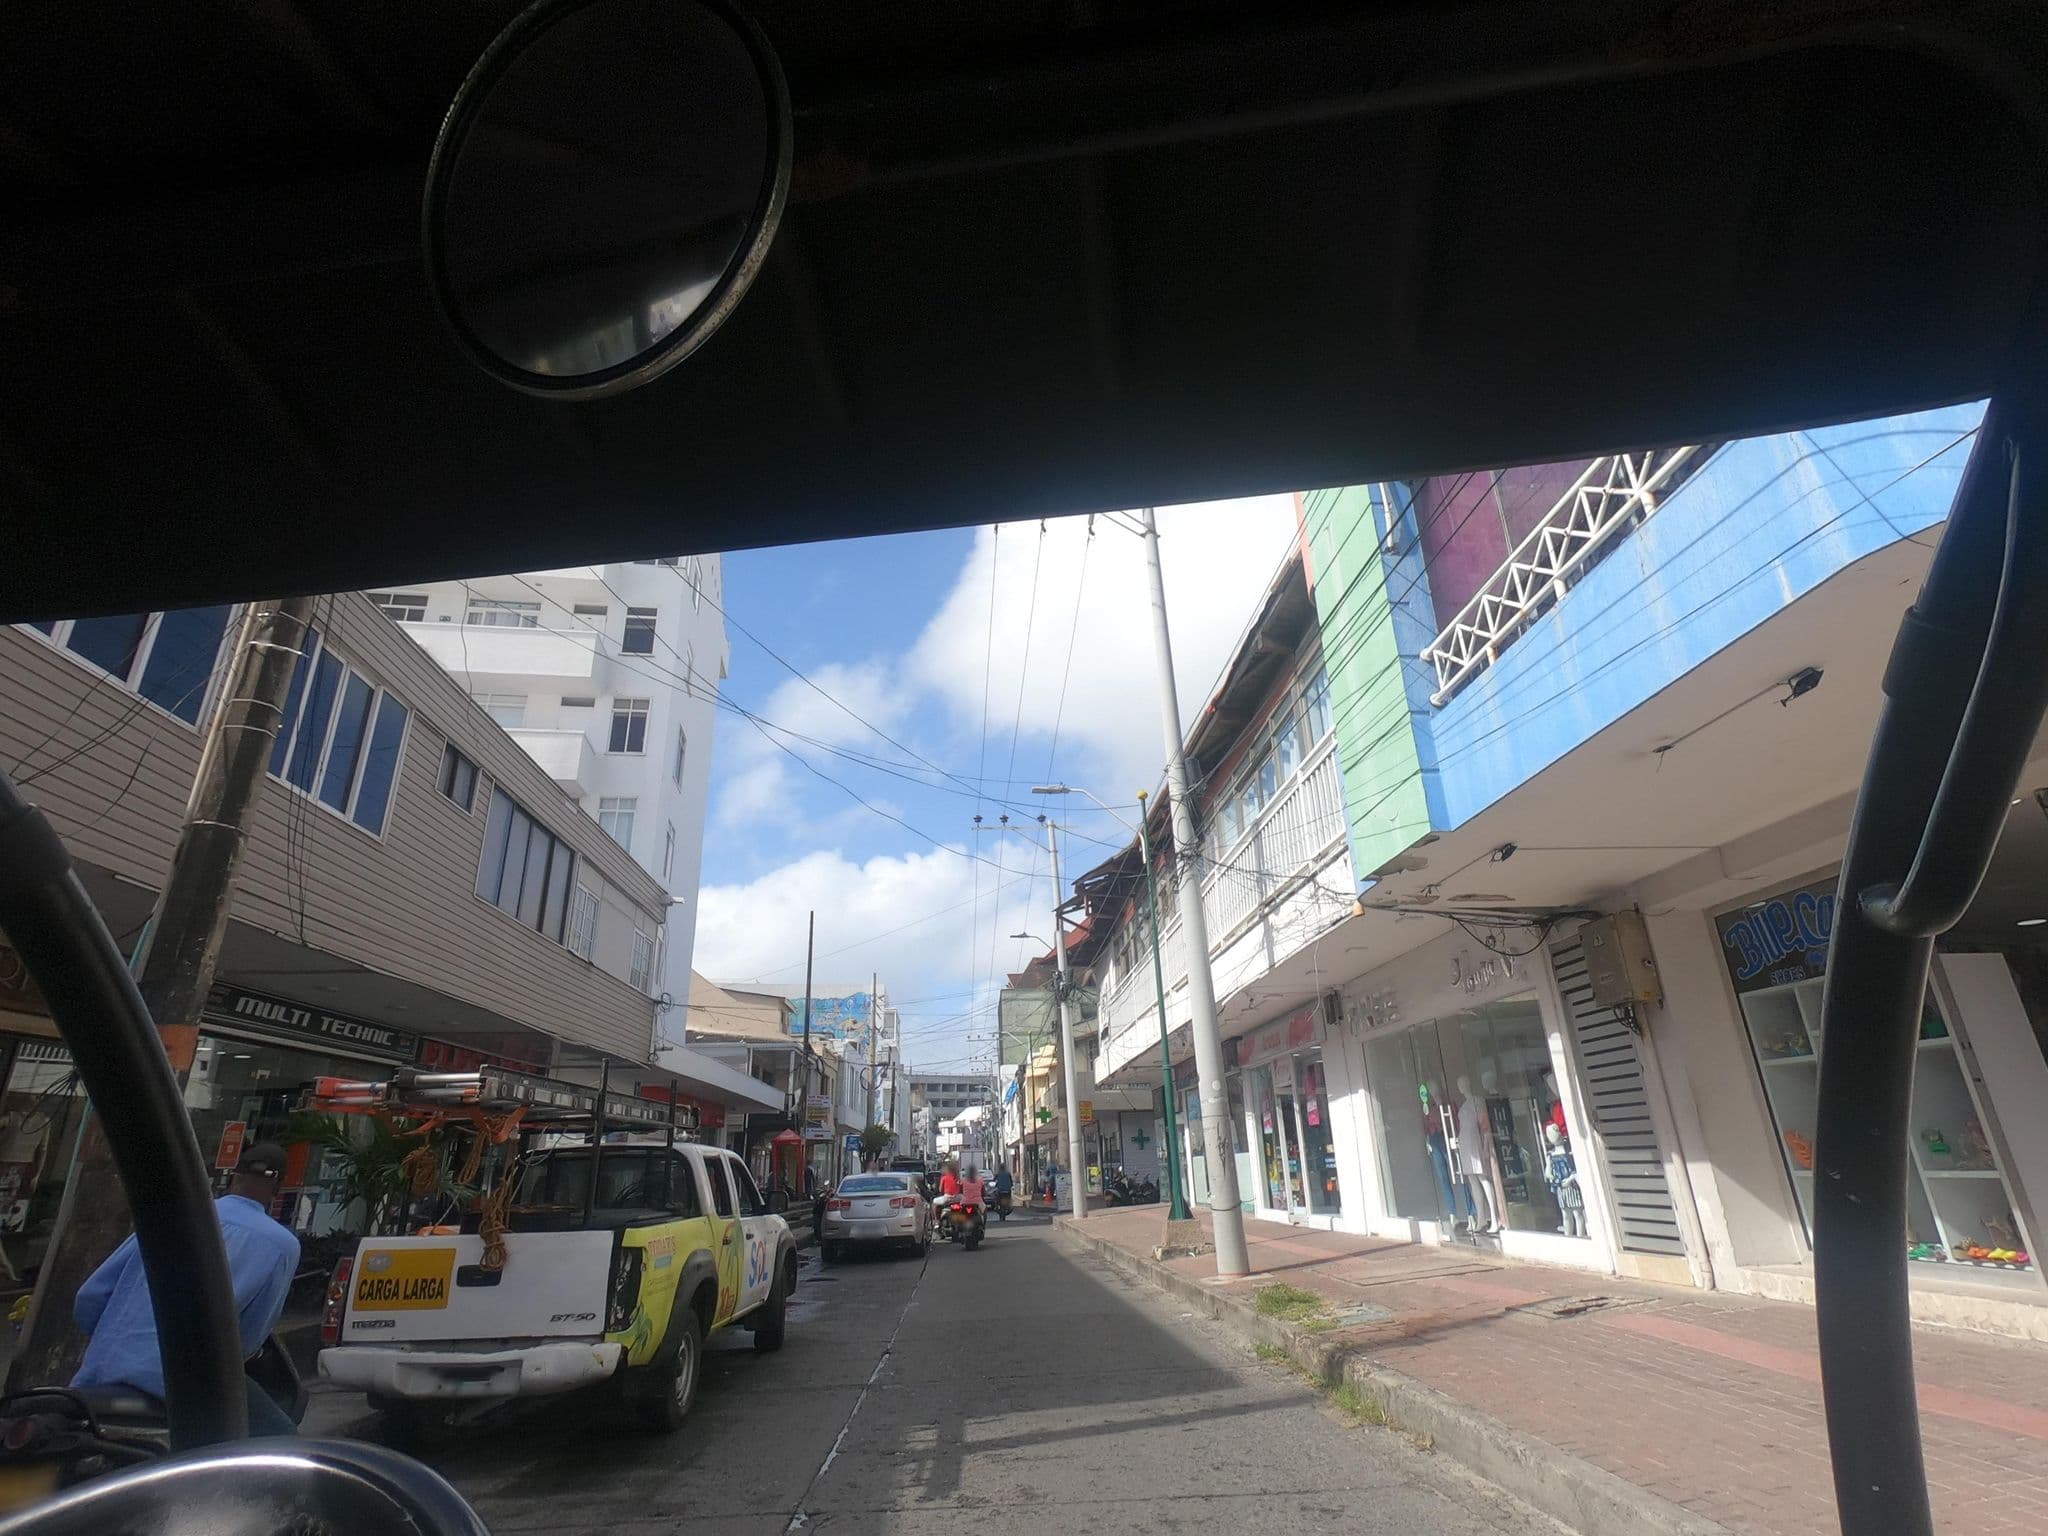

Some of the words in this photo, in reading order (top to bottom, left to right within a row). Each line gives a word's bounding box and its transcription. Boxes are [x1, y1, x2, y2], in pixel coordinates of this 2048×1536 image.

[1724, 900, 1807, 980] Blue
[1793, 890, 1836, 948] Co
[235, 997, 311, 1027] MULTI
[320, 1016, 395, 1046] TECHNIC
[359, 1278, 400, 1301] CARGA
[403, 1278, 444, 1300] LARGA
